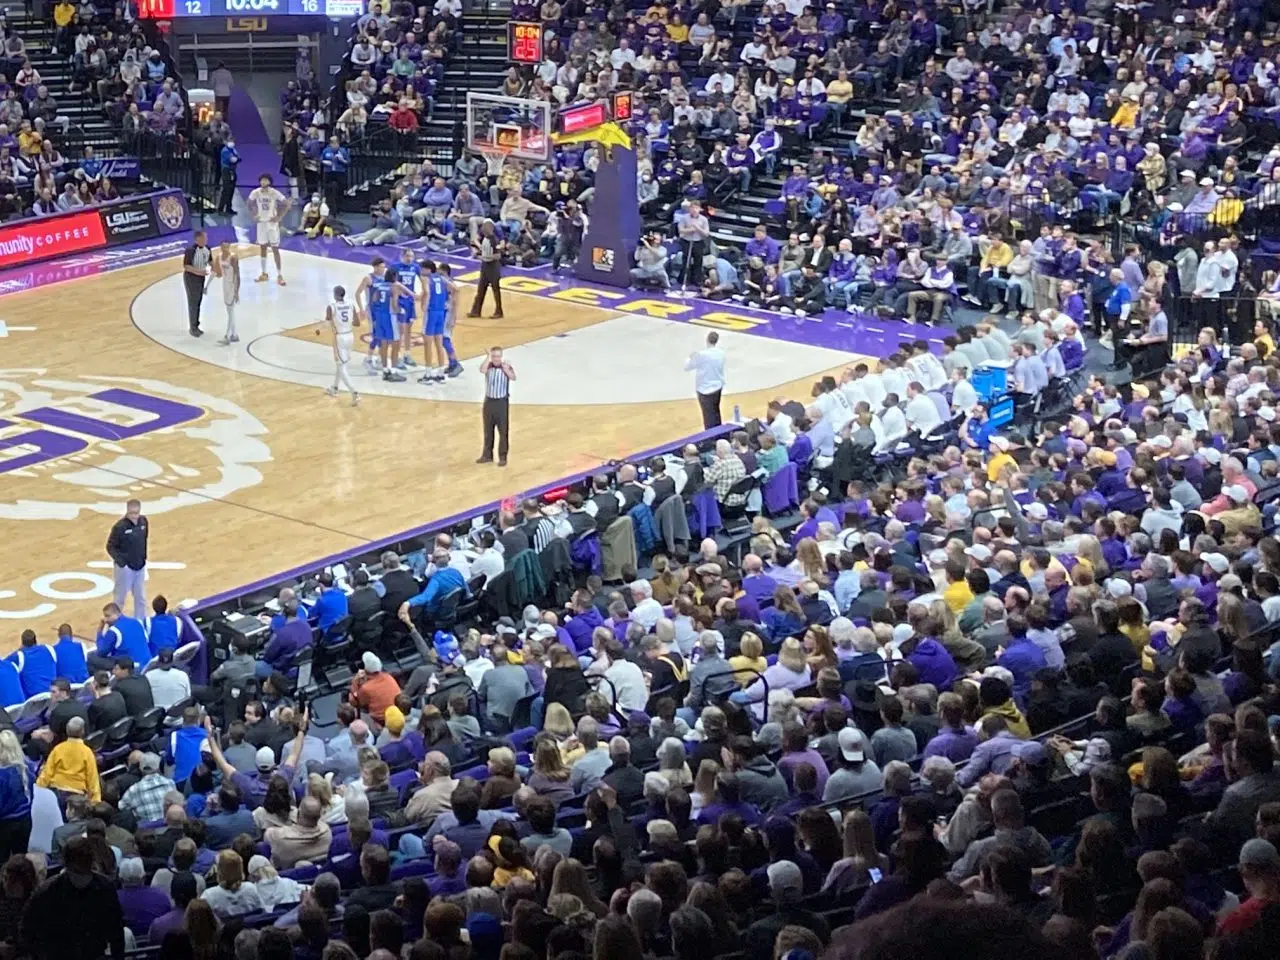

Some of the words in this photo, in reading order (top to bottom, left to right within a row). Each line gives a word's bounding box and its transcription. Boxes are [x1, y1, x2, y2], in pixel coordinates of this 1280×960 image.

[185, 0, 200, 14] 12
[301, 0, 318, 12] 16
[227, 16, 268, 32] LSU
[106, 210, 130, 227] LSU
[36, 225, 90, 248] COFFEE
[341, 311, 349, 323] 5
